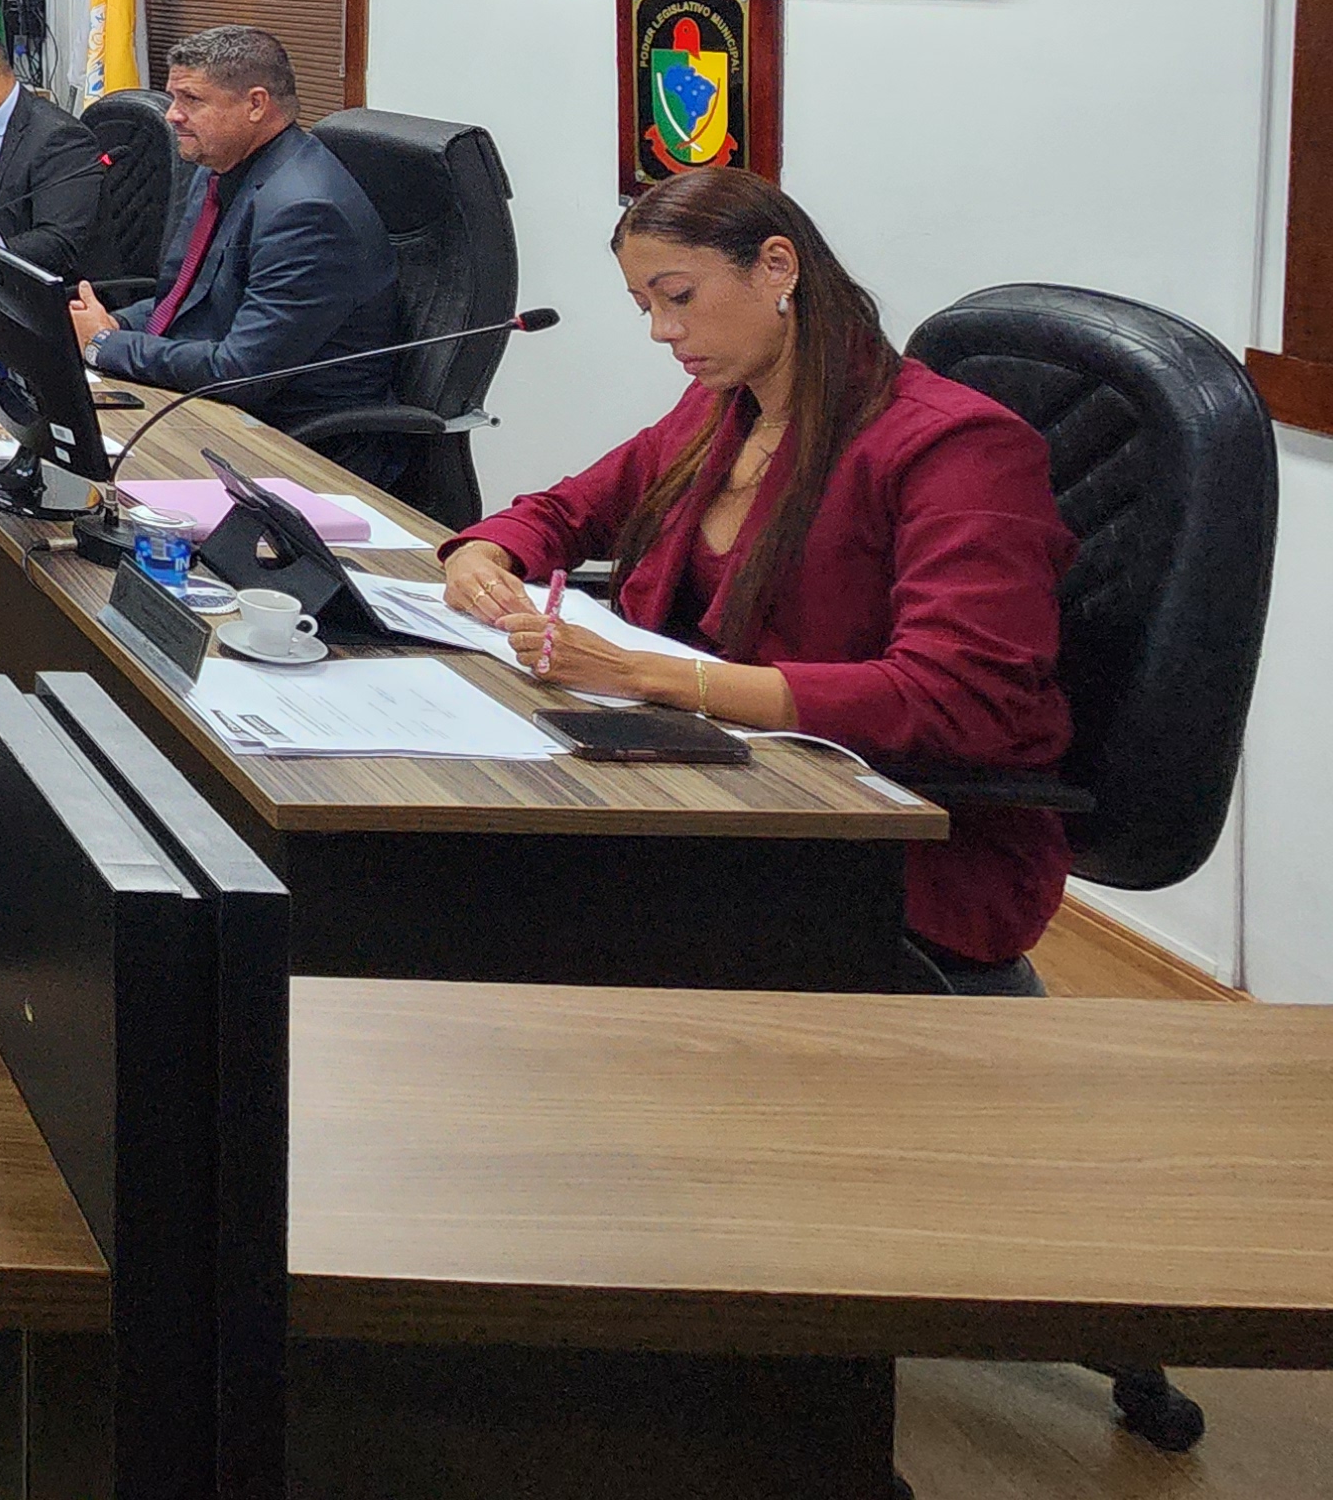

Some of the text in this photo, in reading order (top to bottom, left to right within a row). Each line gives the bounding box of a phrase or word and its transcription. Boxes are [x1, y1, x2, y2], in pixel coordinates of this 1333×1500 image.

[640, 1, 740, 73] PODER LEGISLATIVO MUNICIPAL
